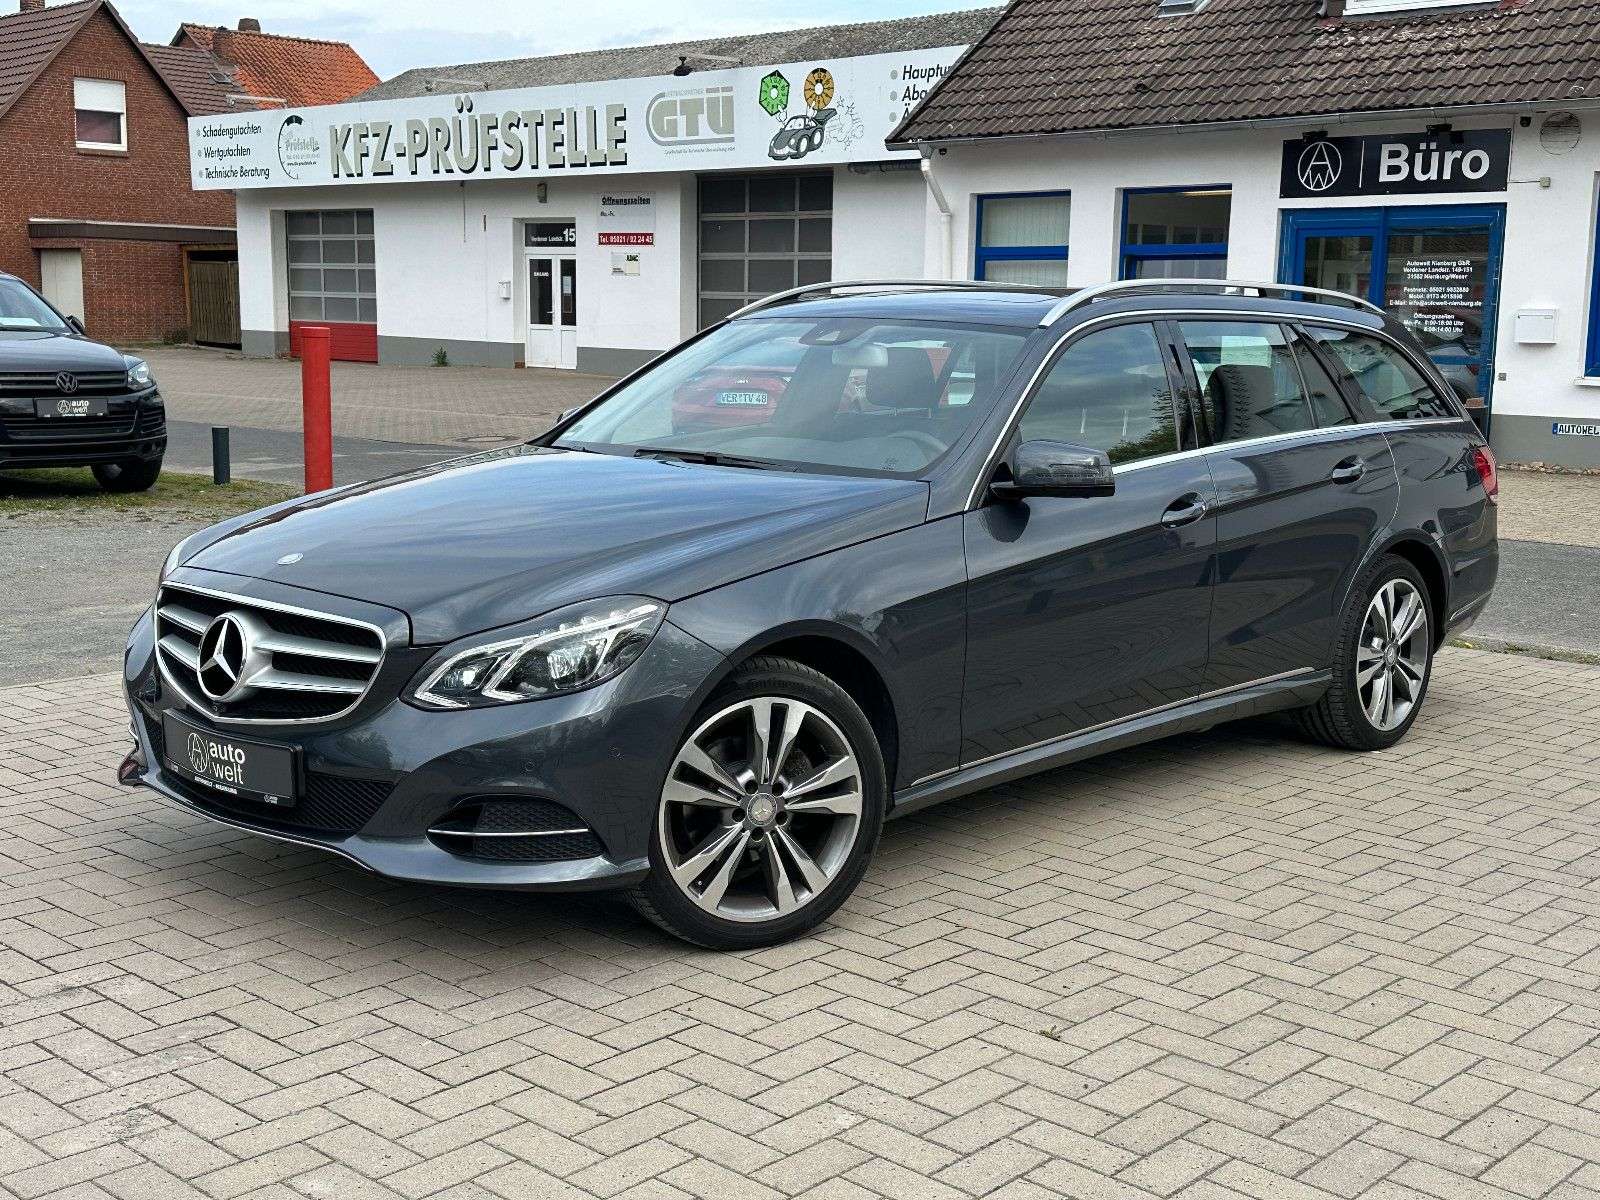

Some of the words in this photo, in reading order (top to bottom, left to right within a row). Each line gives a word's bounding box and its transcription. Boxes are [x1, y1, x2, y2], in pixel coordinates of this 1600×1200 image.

[649, 86, 734, 140] GTÜ
[203, 122, 261, 139] Schadengutachten
[329, 95, 628, 178] KFZ-PRÜFSTELLE
[204, 144, 251, 161] Wertgutachten
[1378, 143, 1490, 184] Büro
[205, 165, 238, 180] Technische
[239, 165, 270, 181] Beratung
[563, 228, 576, 242] 15
[1432, 260, 1457, 268] Nienburg
[1413, 312, 1455, 320] Öffnungszeiten
[72, 399, 90, 407] auto
[210, 741, 246, 765] auto
[212, 761, 244, 785] welt
